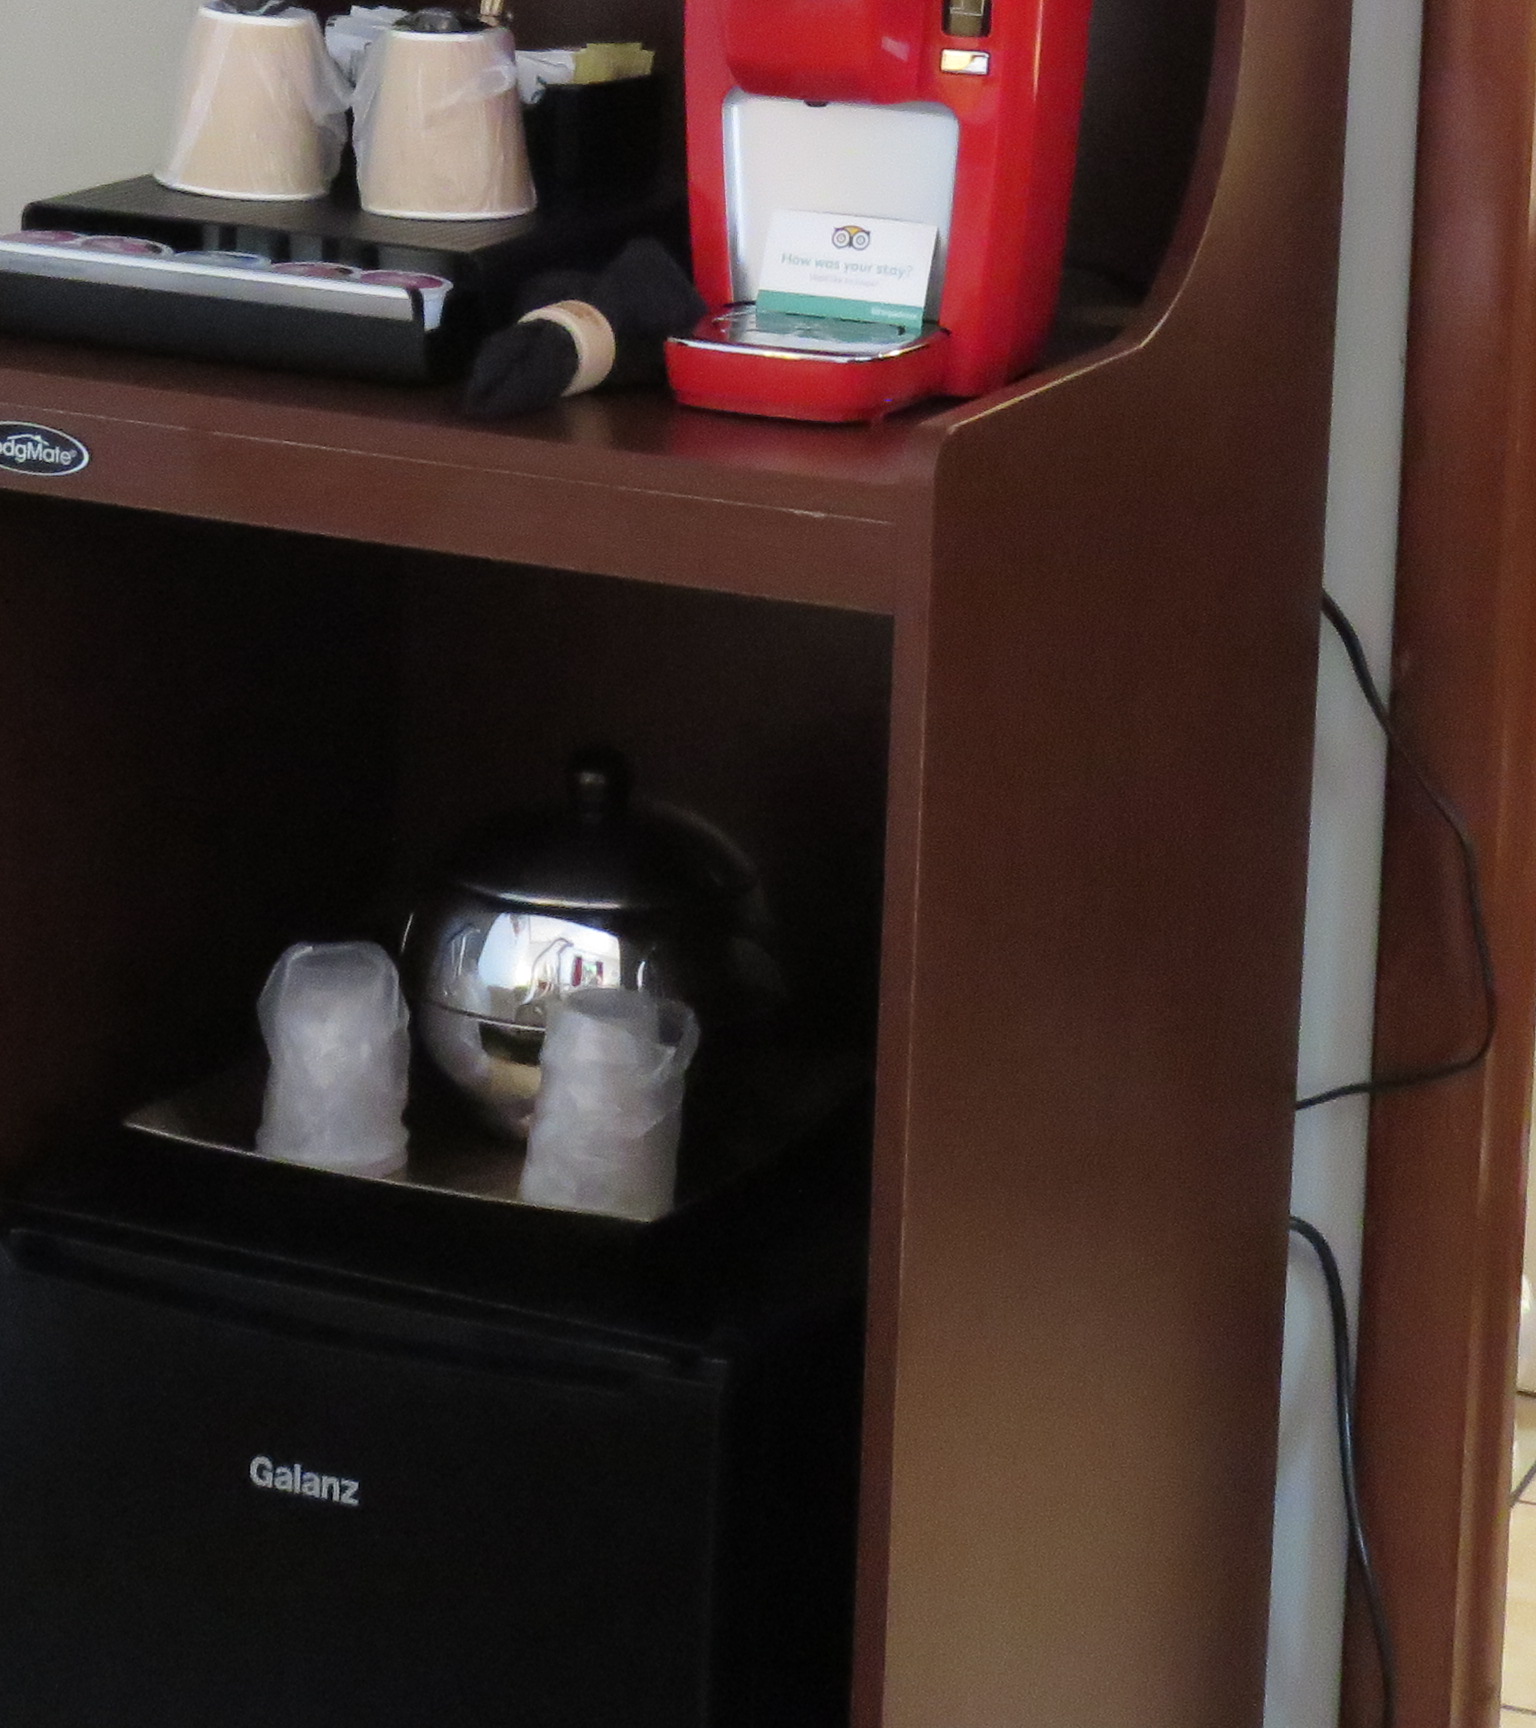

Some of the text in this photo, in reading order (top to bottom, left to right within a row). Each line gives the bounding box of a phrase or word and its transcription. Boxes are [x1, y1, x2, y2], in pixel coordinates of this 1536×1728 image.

[781, 253, 914, 280] How was your stay?
[249, 1455, 360, 1507] Galanz
